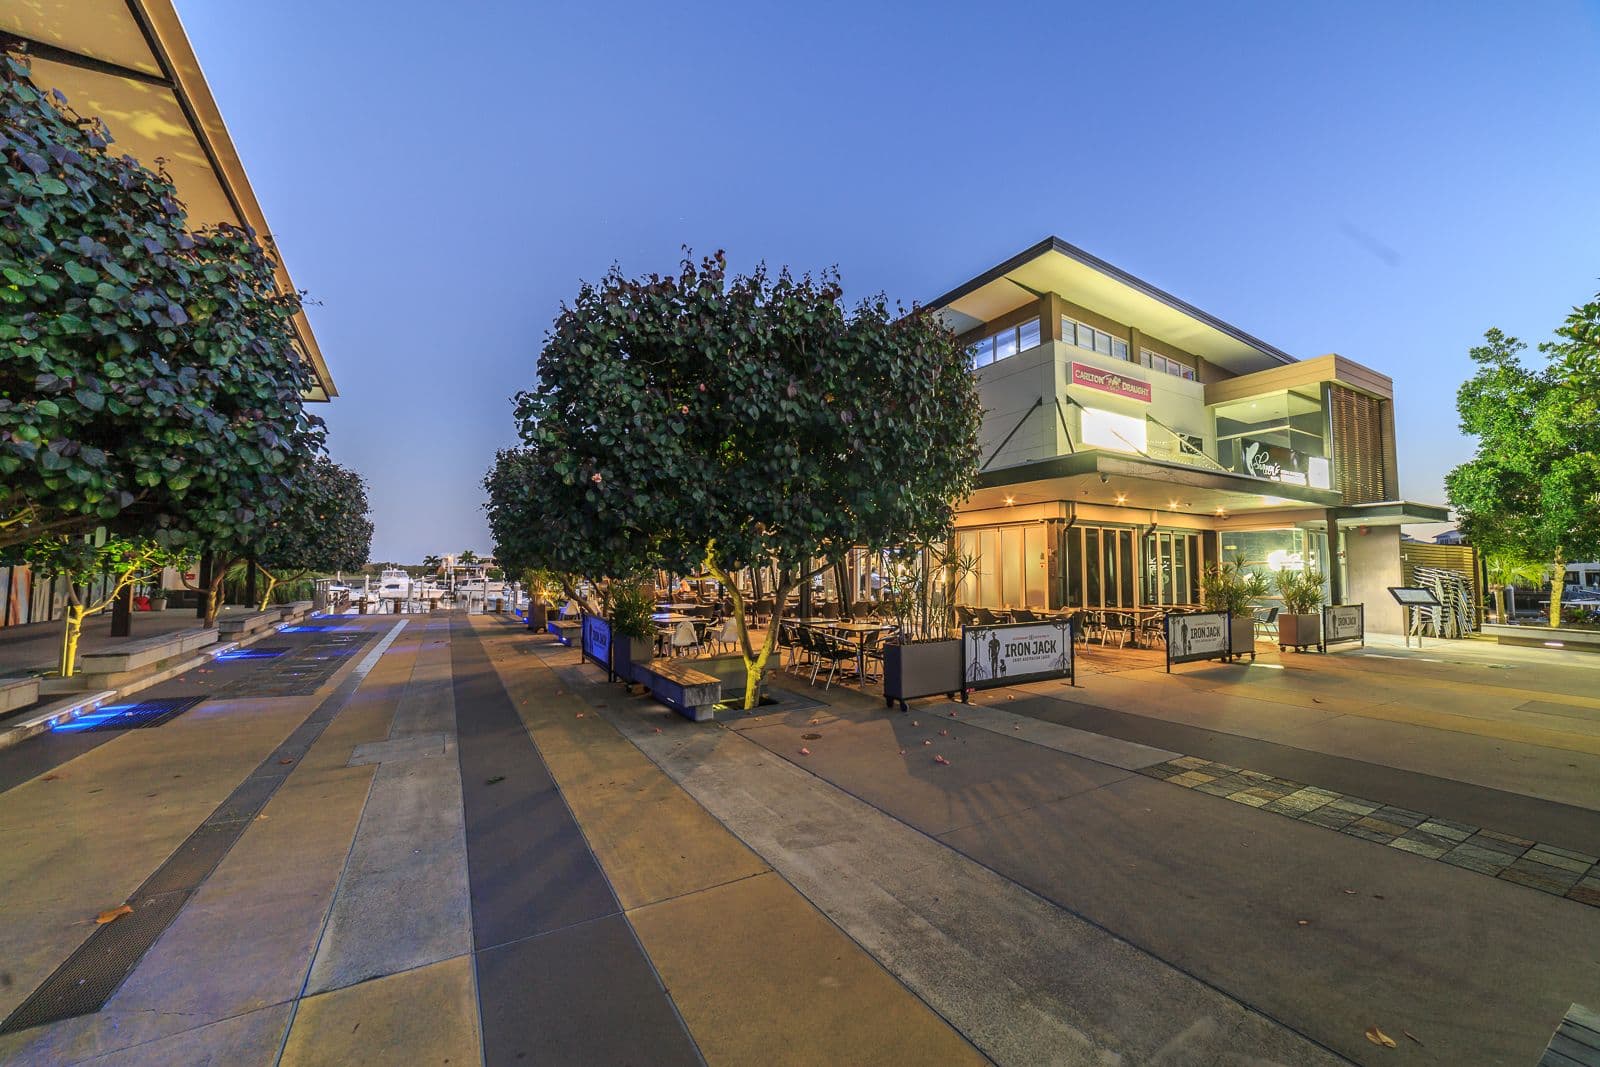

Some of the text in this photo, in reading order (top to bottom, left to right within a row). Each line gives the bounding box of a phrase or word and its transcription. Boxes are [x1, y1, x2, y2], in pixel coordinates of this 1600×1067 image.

[1075, 369, 1149, 395] CARLTON DRAUGHT
[1191, 626, 1220, 639] IRON JACK
[1005, 639, 1056, 657] IRON JACK
